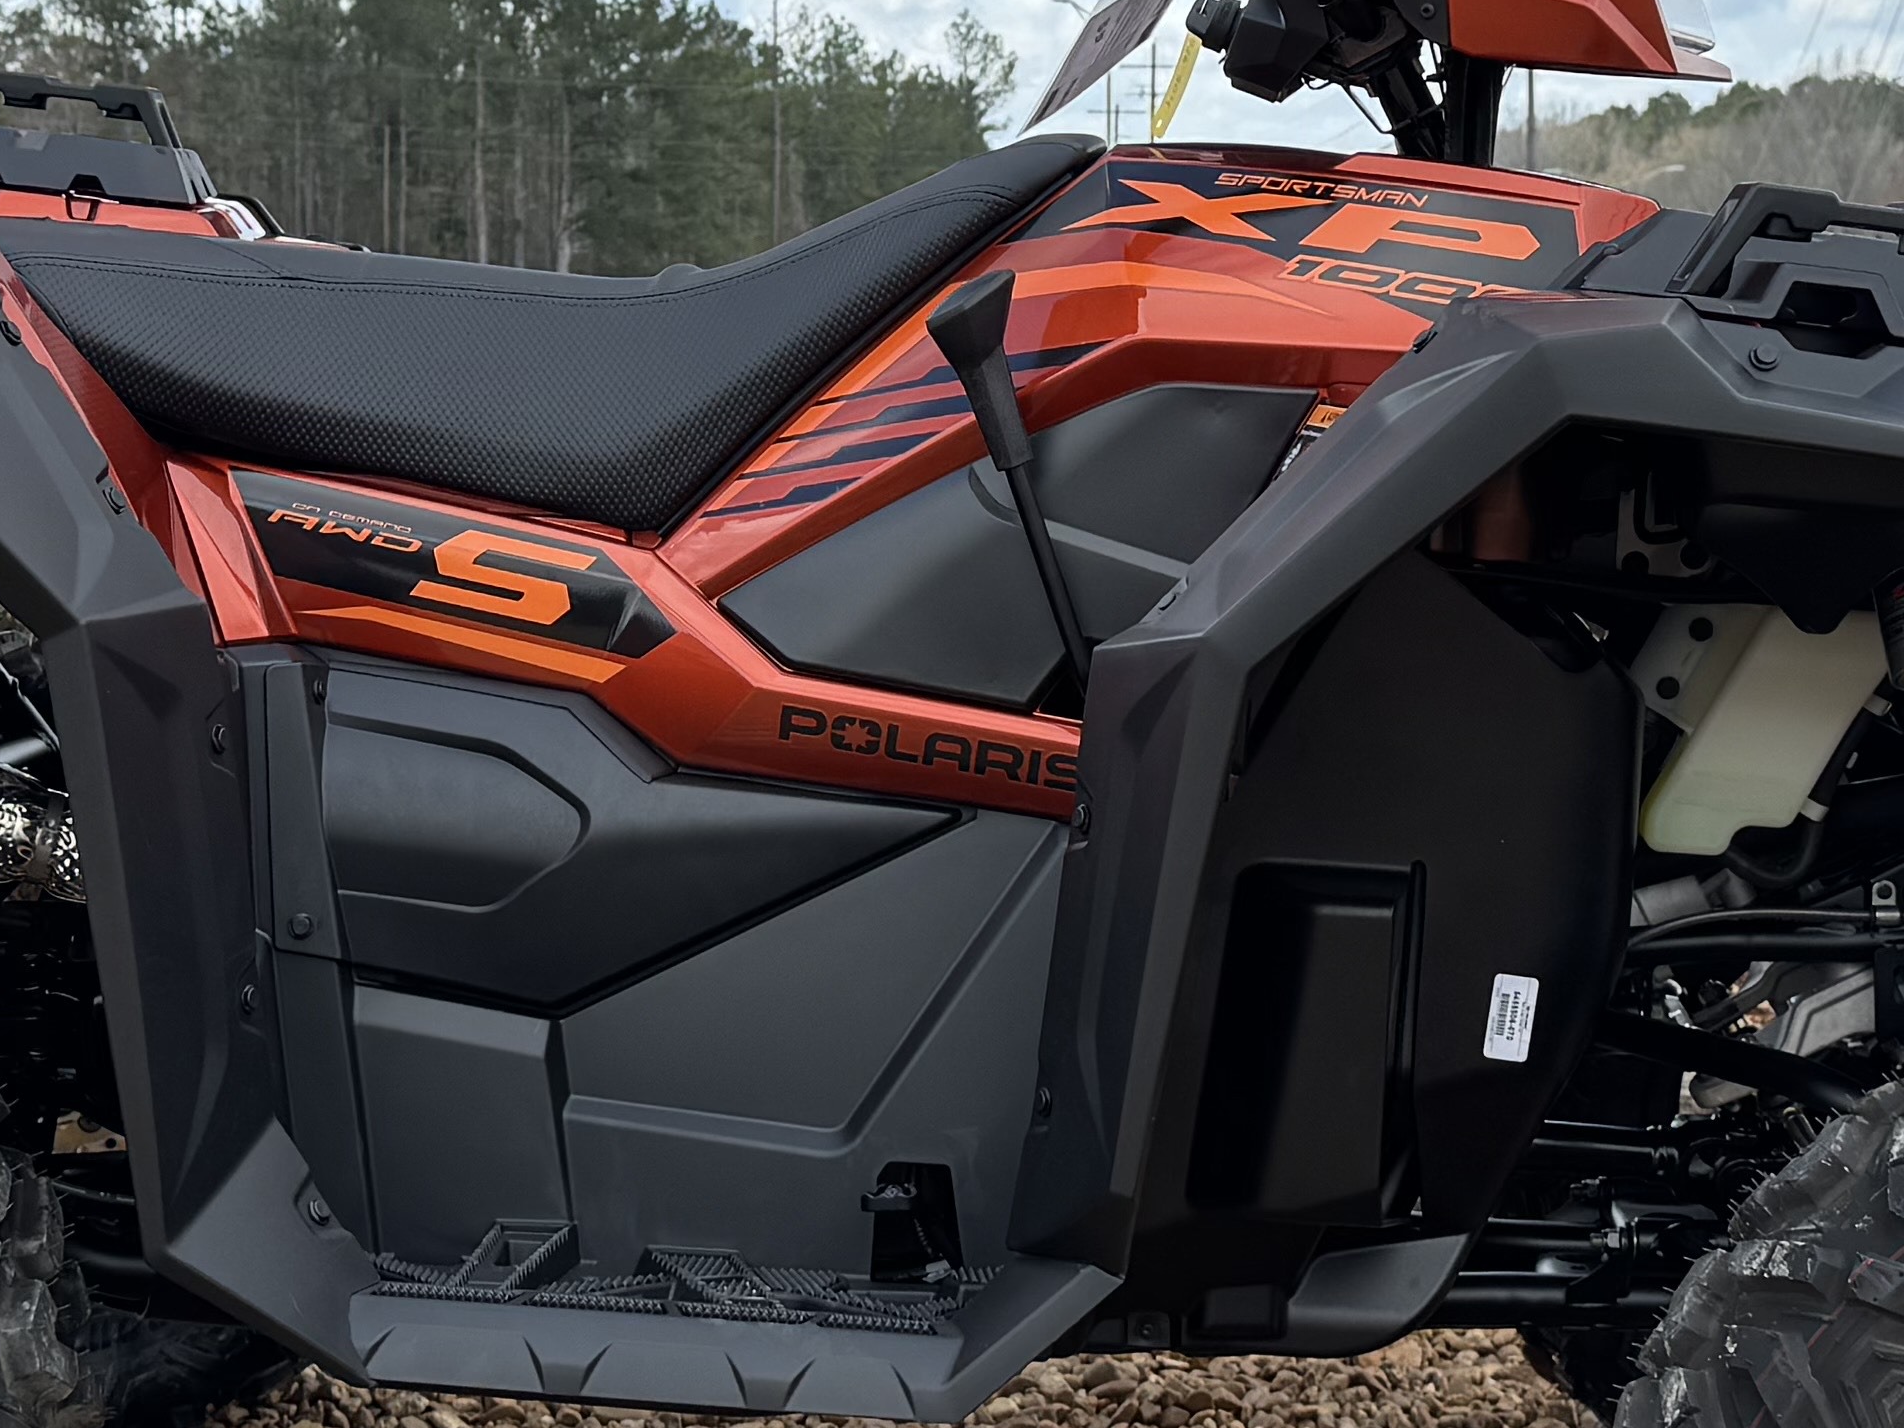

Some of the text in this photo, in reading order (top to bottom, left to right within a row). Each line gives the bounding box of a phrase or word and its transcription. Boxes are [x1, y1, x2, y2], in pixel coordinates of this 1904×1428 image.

[1059, 178, 1541, 261] XP
[1214, 173, 1429, 208] SPORTSMAN
[1277, 254, 1528, 305] 100
[268, 508, 597, 626] AWD S
[778, 704, 1079, 792] POLARIS
